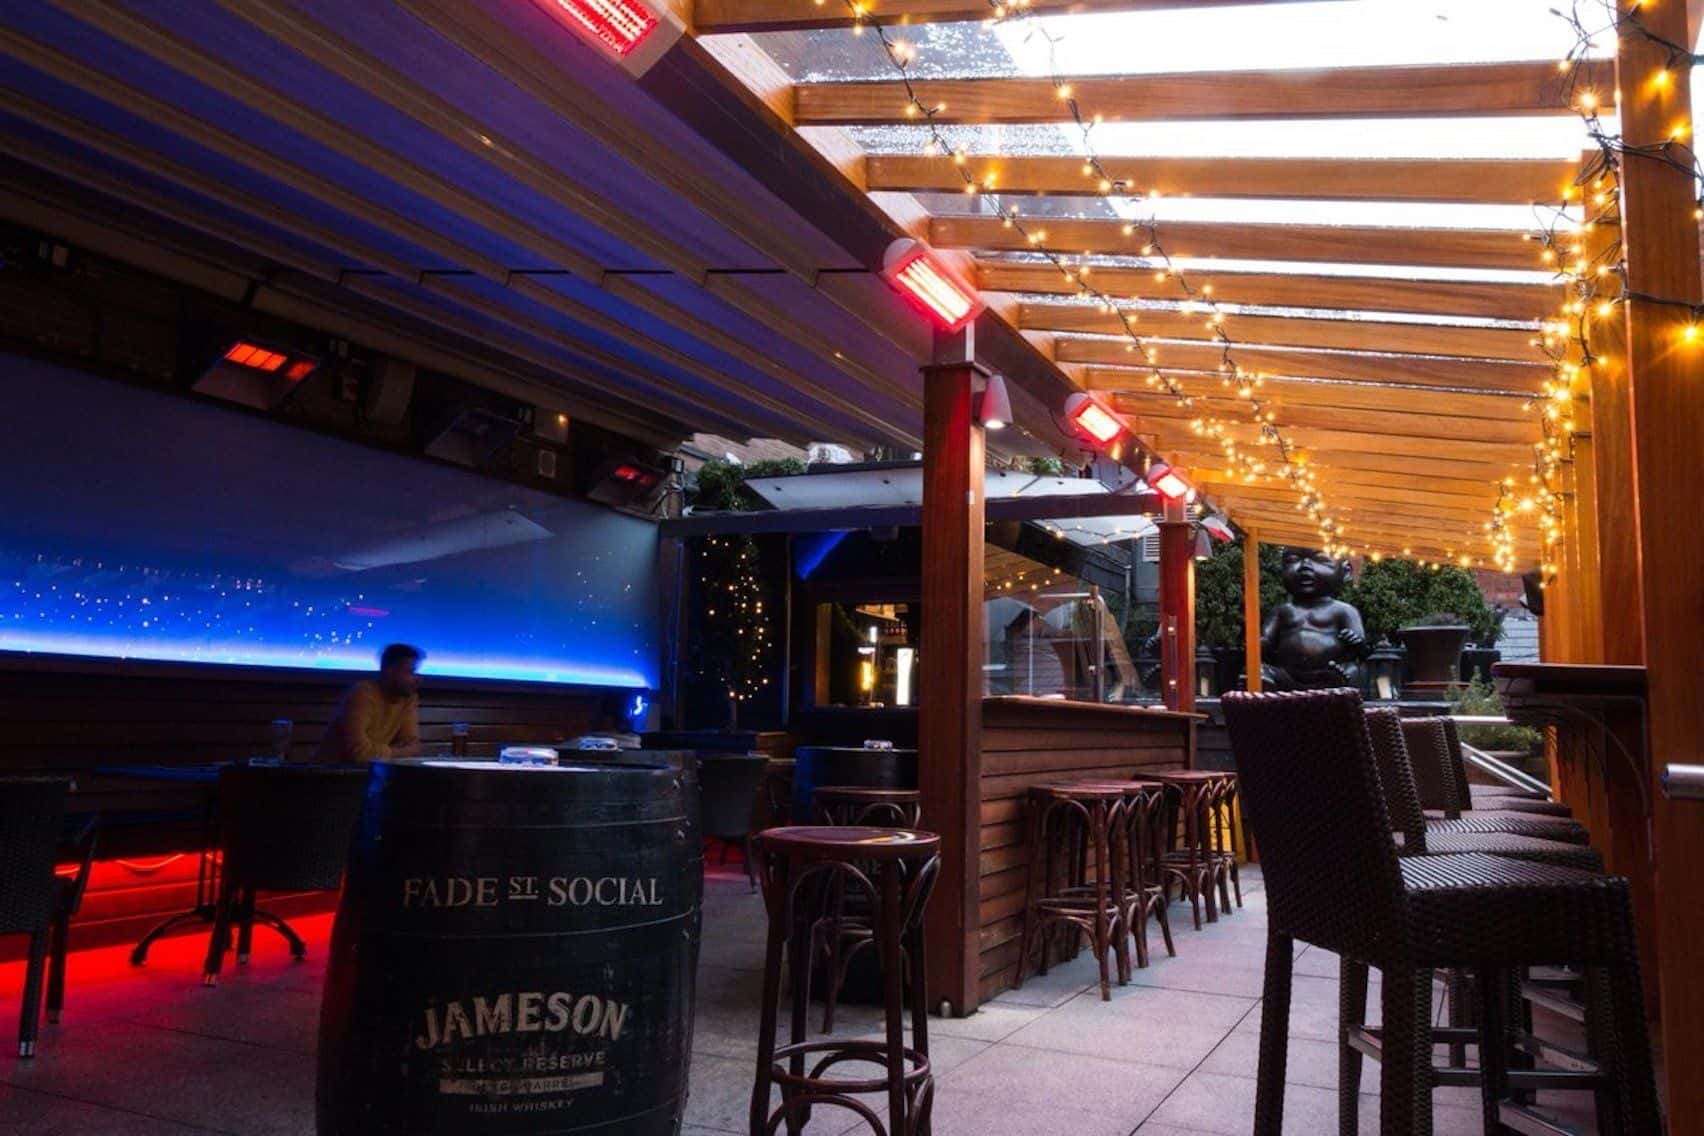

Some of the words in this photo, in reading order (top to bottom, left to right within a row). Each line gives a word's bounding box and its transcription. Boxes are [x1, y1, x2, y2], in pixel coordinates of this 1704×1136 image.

[403, 877, 499, 907] FADE
[547, 876, 664, 907] SOCIAL
[415, 990, 630, 1050] JAMESON
[522, 1051, 607, 1072] RESERVE
[469, 1103, 508, 1113] IRISH
